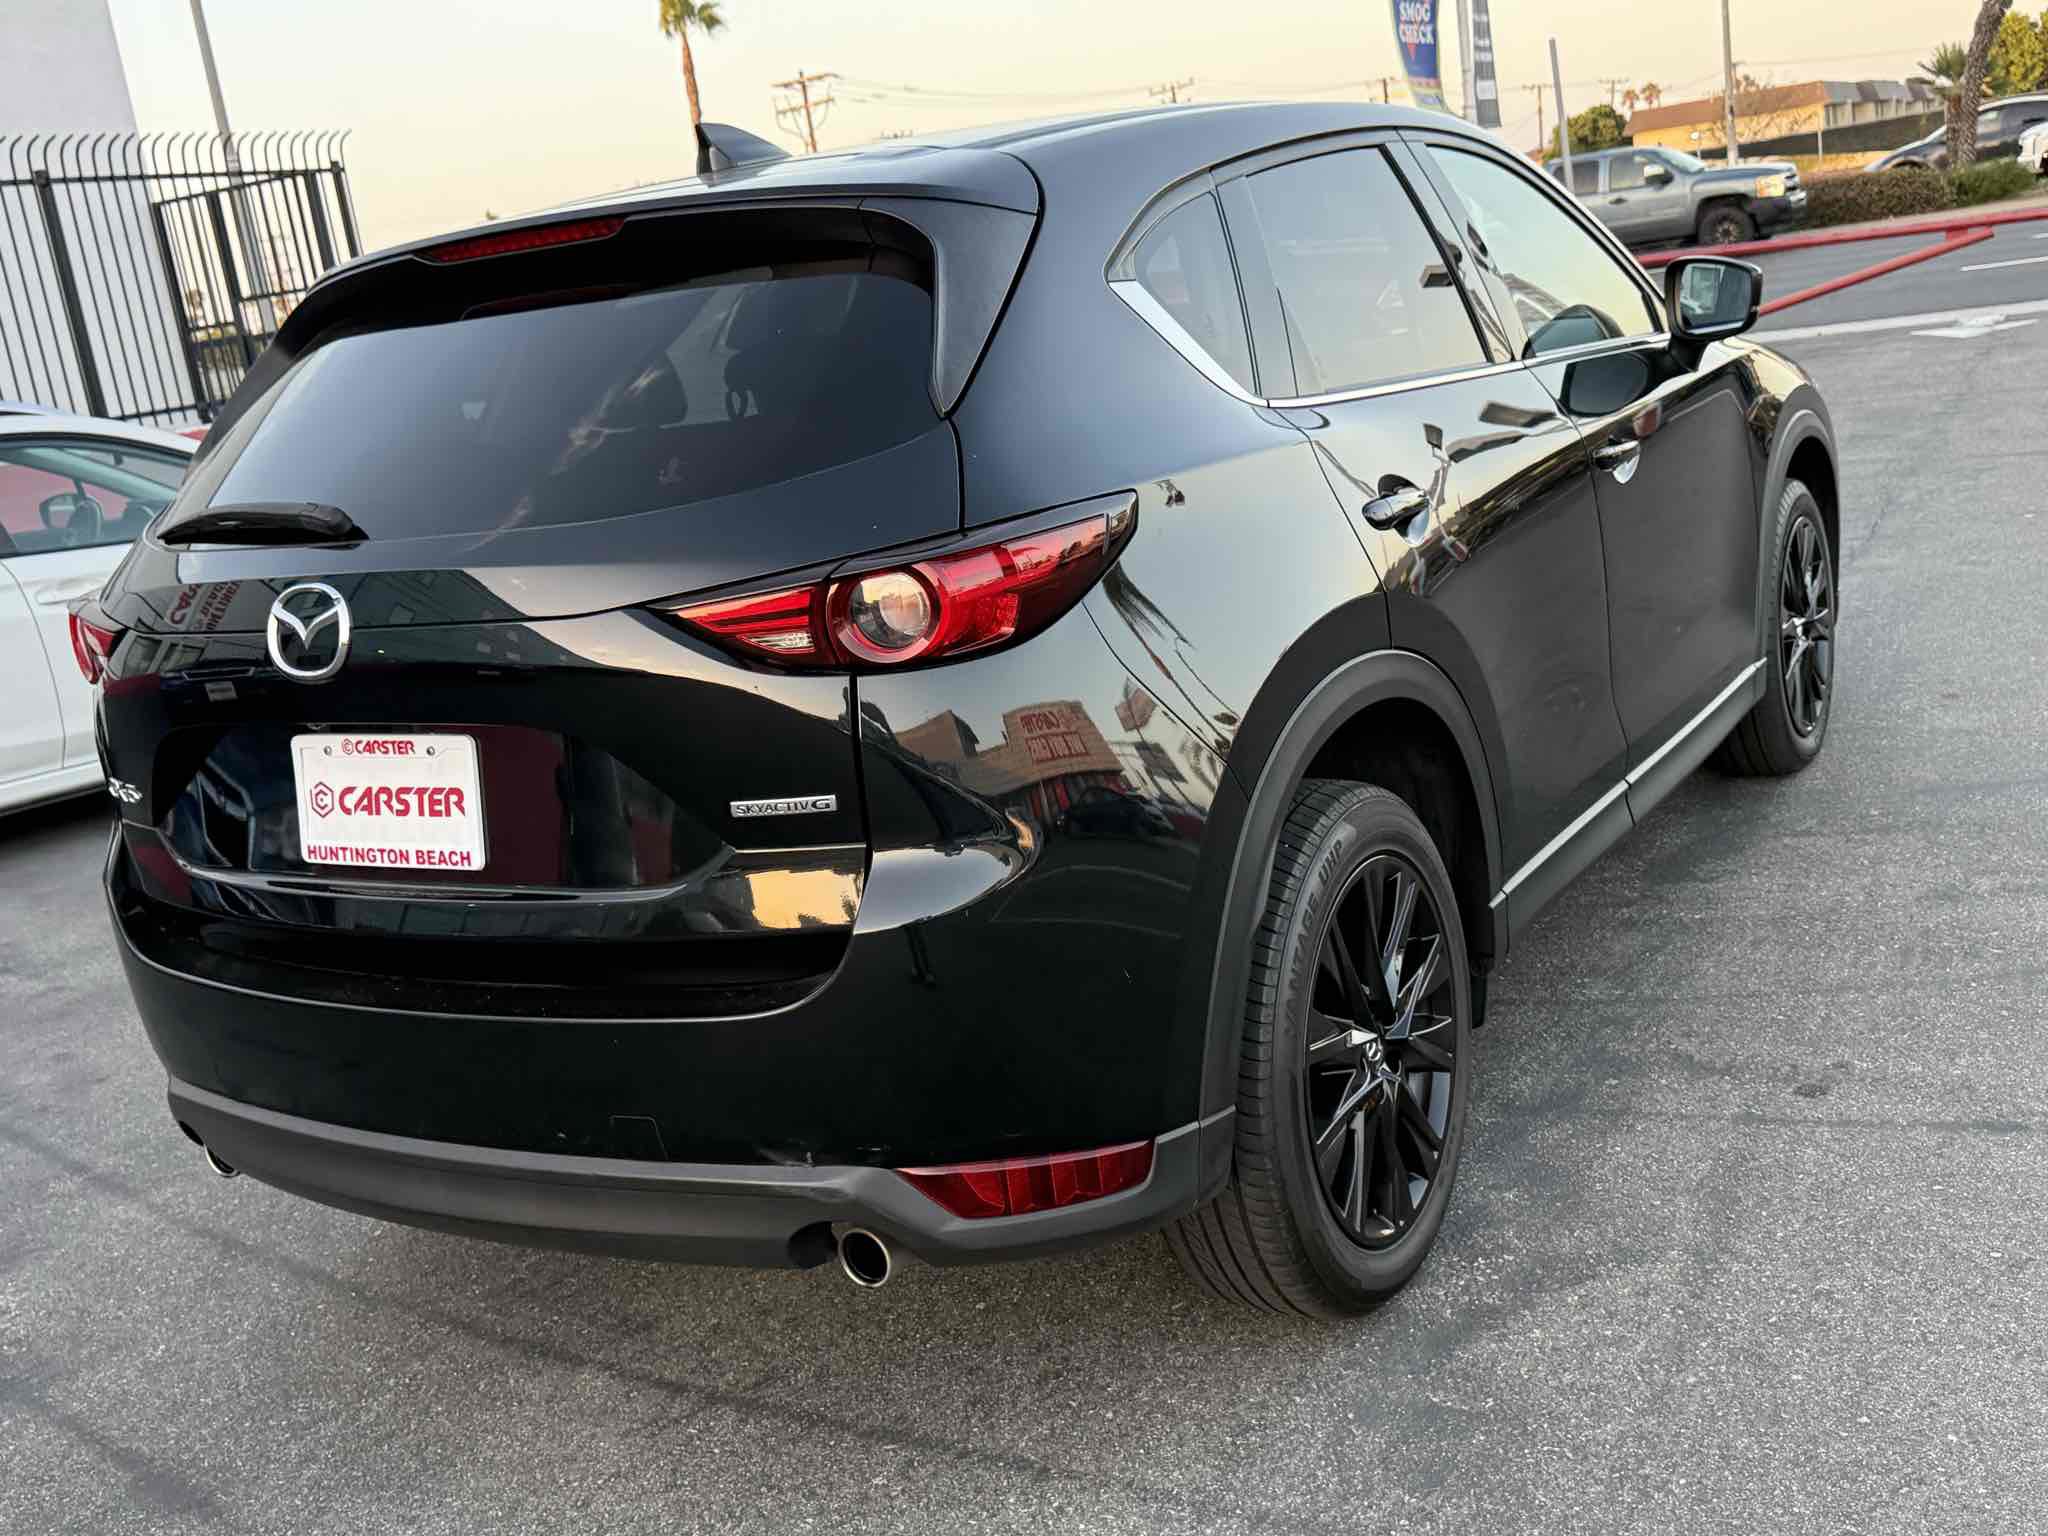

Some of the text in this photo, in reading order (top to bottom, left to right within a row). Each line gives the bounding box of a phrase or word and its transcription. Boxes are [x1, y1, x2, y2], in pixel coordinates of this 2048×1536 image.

[1399, 1, 1430, 21] SMOG
[1399, 23, 1434, 44] CHECK
[355, 740, 416, 755] CARSTER
[338, 786, 466, 817] CARSTER
[307, 844, 472, 867] HUNTINGTON BEACH
